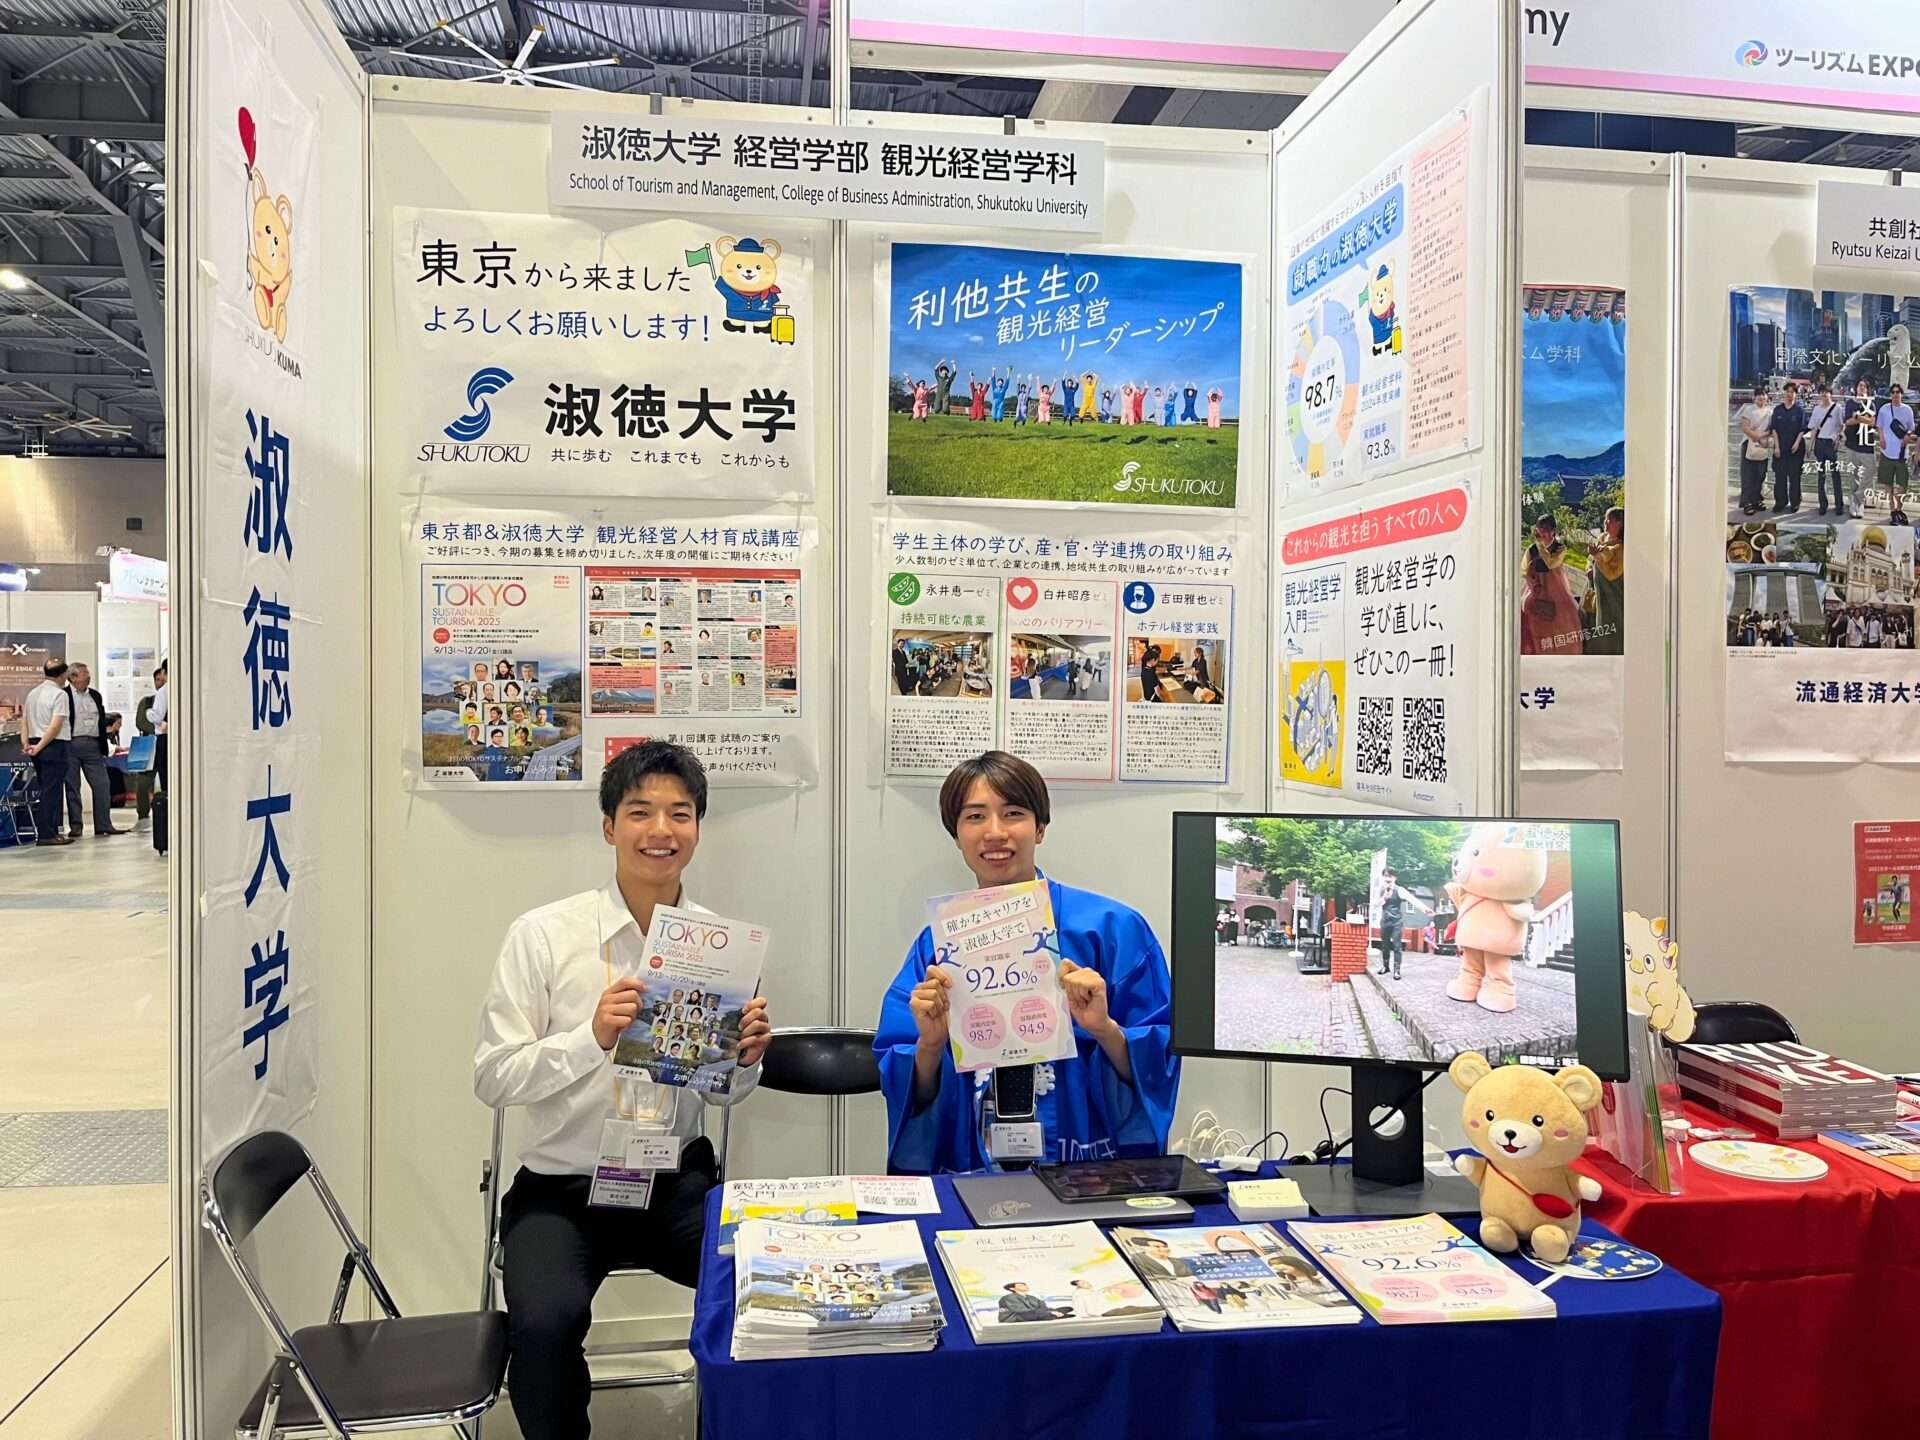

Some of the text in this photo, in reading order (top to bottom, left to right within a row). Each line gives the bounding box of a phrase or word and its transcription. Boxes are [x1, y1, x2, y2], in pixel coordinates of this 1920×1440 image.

[1776, 48, 1920, 78] ツーリズムEXP
[580, 123, 1078, 186] 淑徳大学 経営学部 観光経営学科
[569, 172, 1089, 219] School of Tourism and Management, College of Business Administration, Shukutoku University
[416, 238, 691, 292] 東京から来ました
[1832, 241, 1872, 259] Ryutsu
[1876, 246, 1911, 260] Keizai
[906, 264, 1100, 331] 利他共生の
[995, 297, 1111, 346] 観光経営
[1059, 301, 1225, 361] リーダーシップ
[543, 382, 797, 444] 淑徳大学
[416, 443, 531, 465] SHUKUTOKU
[550, 447, 791, 469] 共に歩む これまでも これからも
[1131, 476, 1225, 495] SHUKUTOKU
[421, 521, 801, 549] 東京都&淑徳大学 観光経営人材育成講座
[1286, 503, 1459, 557] これからの観光を担う すべての人へ
[1285, 573, 1341, 606] 観光経営学
[1355, 552, 1456, 596] 観光経営学の
[432, 583, 527, 607] TOKYO
[432, 616, 475, 626] TOURISM
[900, 612, 986, 627] 持続可能な農業
[1137, 621, 1218, 635] ホテル経営実践
[1284, 609, 1307, 635] 入門
[1360, 601, 1444, 637] 学び直しに、
[1354, 644, 1454, 677] ぜひこの一冊!
[242, 407, 295, 1082] 淑徳大学
[946, 896, 1032, 933] 確かなキャリアを
[659, 919, 728, 950] TOKYO
[964, 921, 1025, 952] 淑徳大学で
[966, 962, 1038, 993] 92.6%
[768, 1228, 861, 1243] TOKYO
